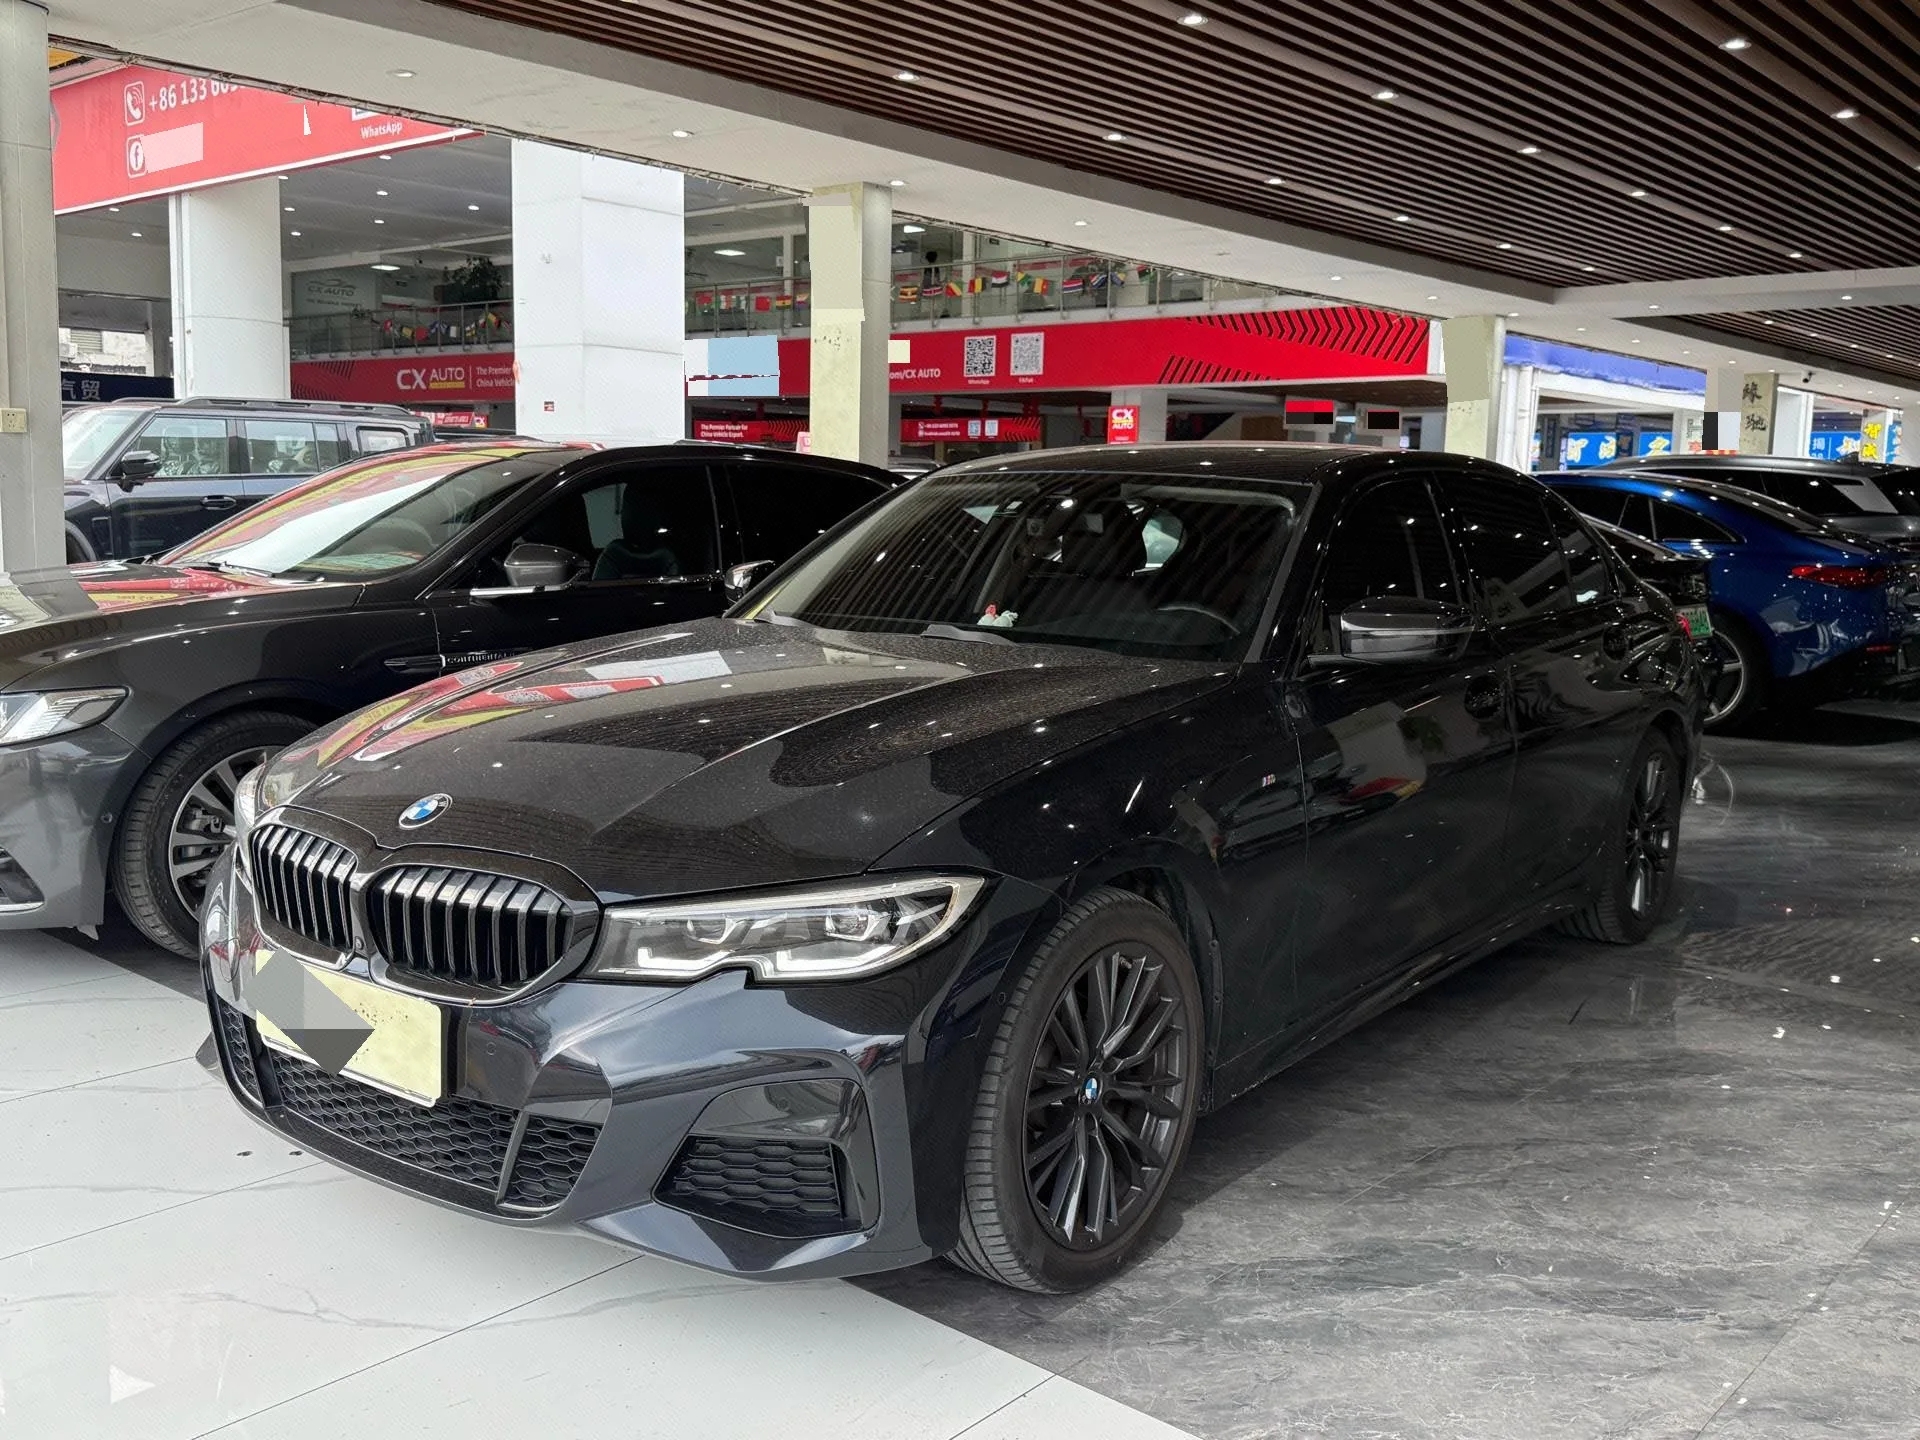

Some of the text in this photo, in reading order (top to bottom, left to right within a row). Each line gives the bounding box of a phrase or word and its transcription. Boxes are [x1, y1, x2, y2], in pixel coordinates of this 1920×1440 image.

[148, 84, 177, 111] +86
[181, 78, 207, 105] 133
[360, 121, 403, 139] WhatsApp
[397, 367, 465, 390] CX AUTO
[917, 368, 941, 379] AUTO
[1112, 409, 1134, 420] CX
